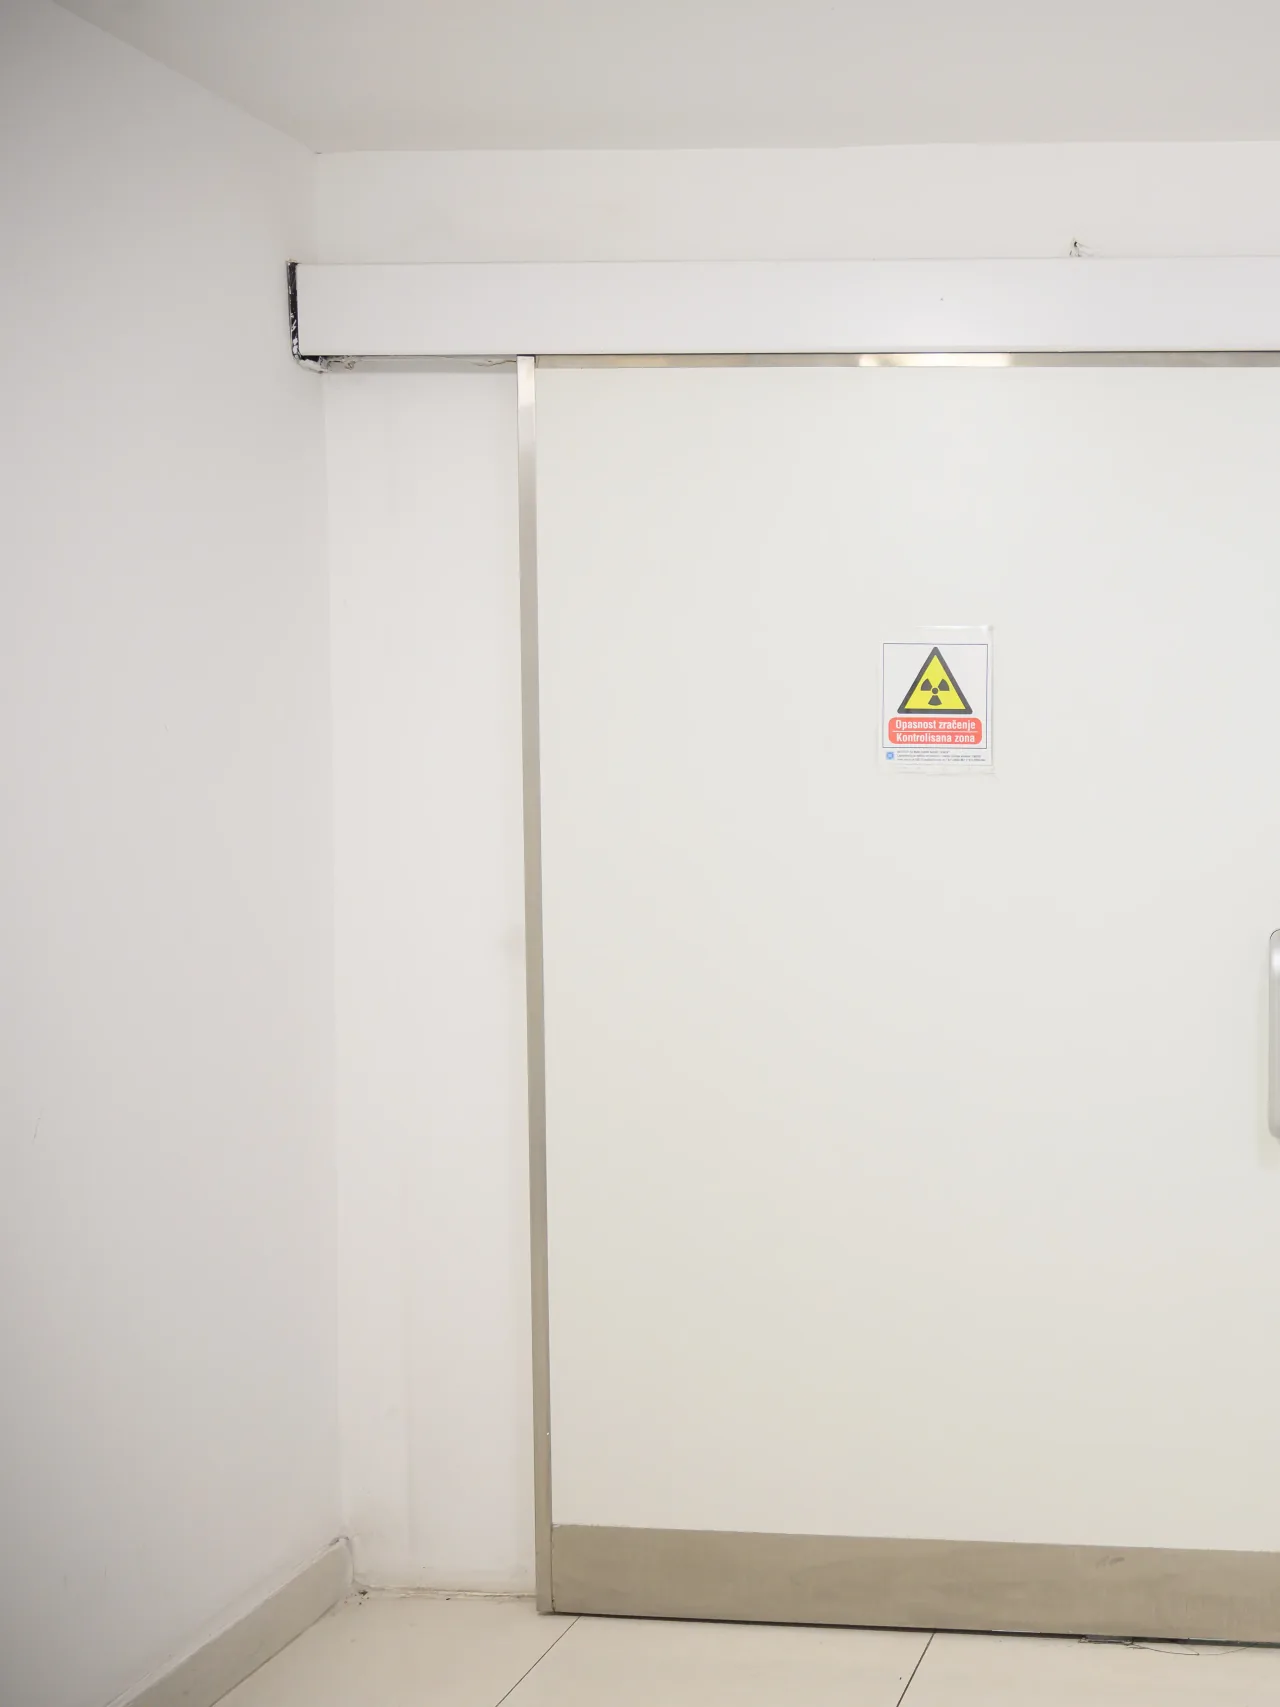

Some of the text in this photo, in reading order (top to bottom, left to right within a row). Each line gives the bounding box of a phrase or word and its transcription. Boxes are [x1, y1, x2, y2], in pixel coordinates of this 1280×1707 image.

[895, 719, 976, 732] Opasnost zračenje
[896, 732, 975, 743] Kontrolisana zona
